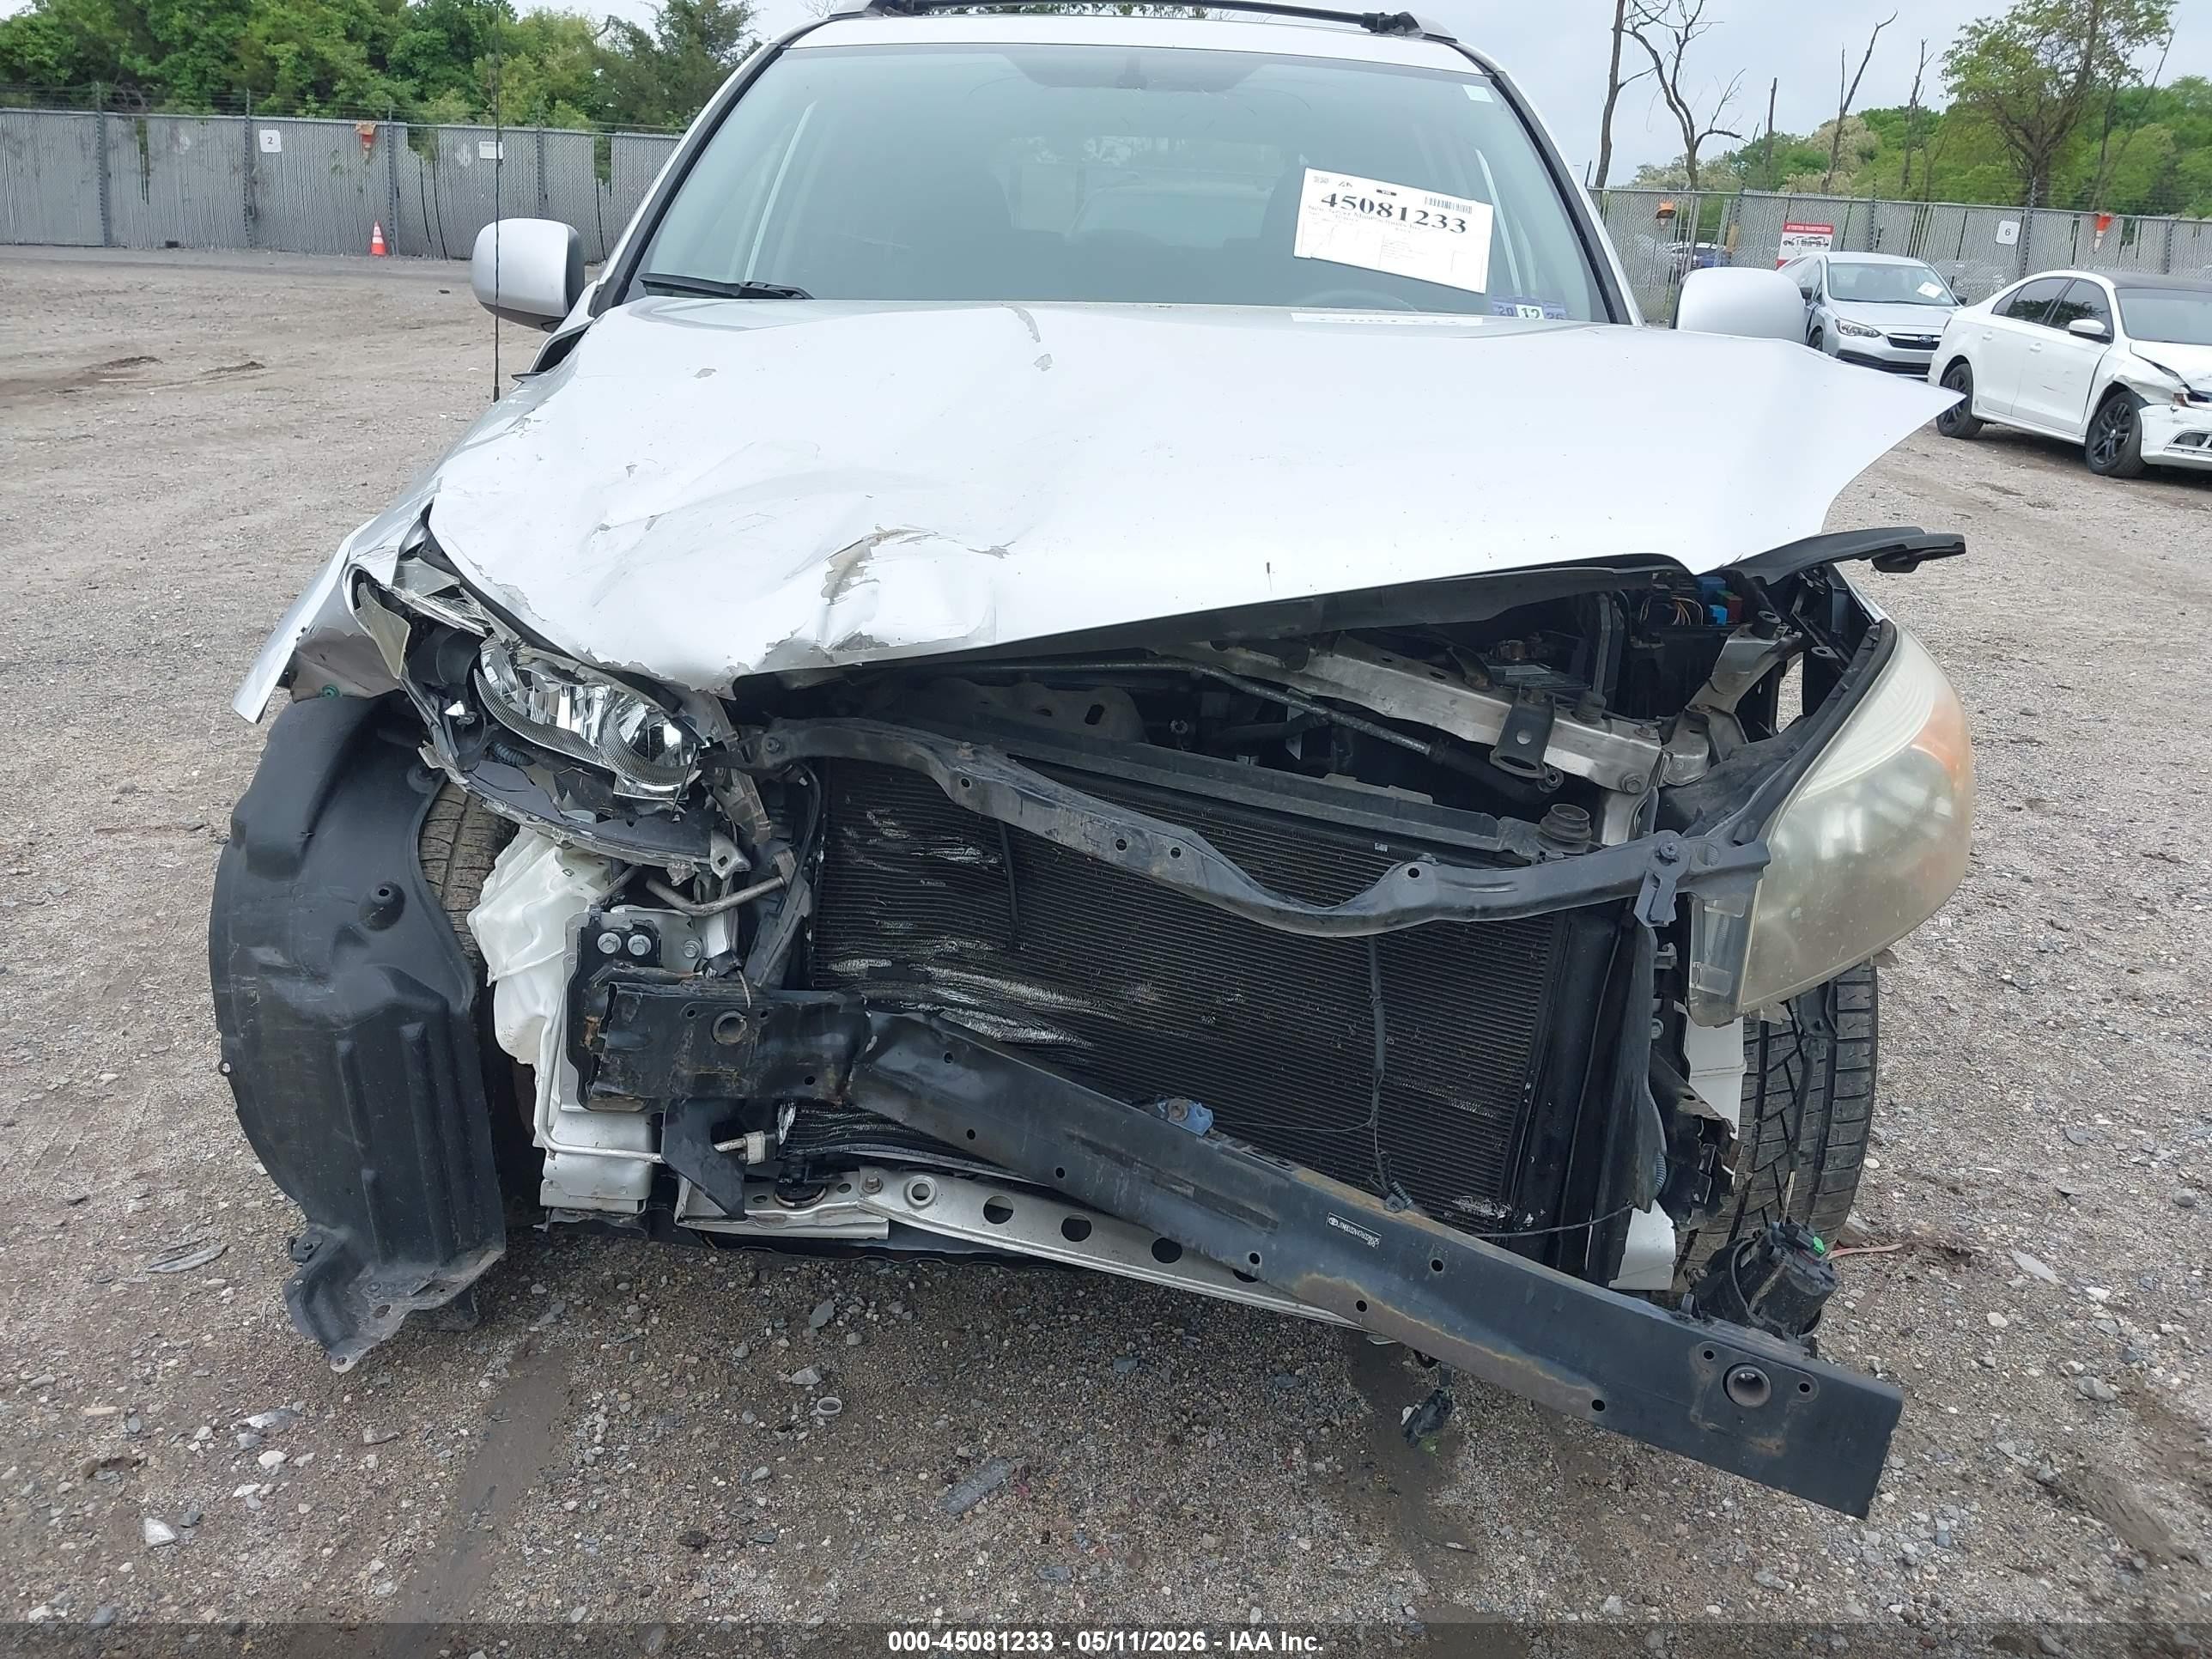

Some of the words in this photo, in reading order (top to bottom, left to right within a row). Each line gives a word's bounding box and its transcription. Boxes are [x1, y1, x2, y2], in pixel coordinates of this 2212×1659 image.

[267, 137, 274, 145] 2
[1321, 193, 1467, 234] 45081233
[2004, 228, 2011, 236] 6
